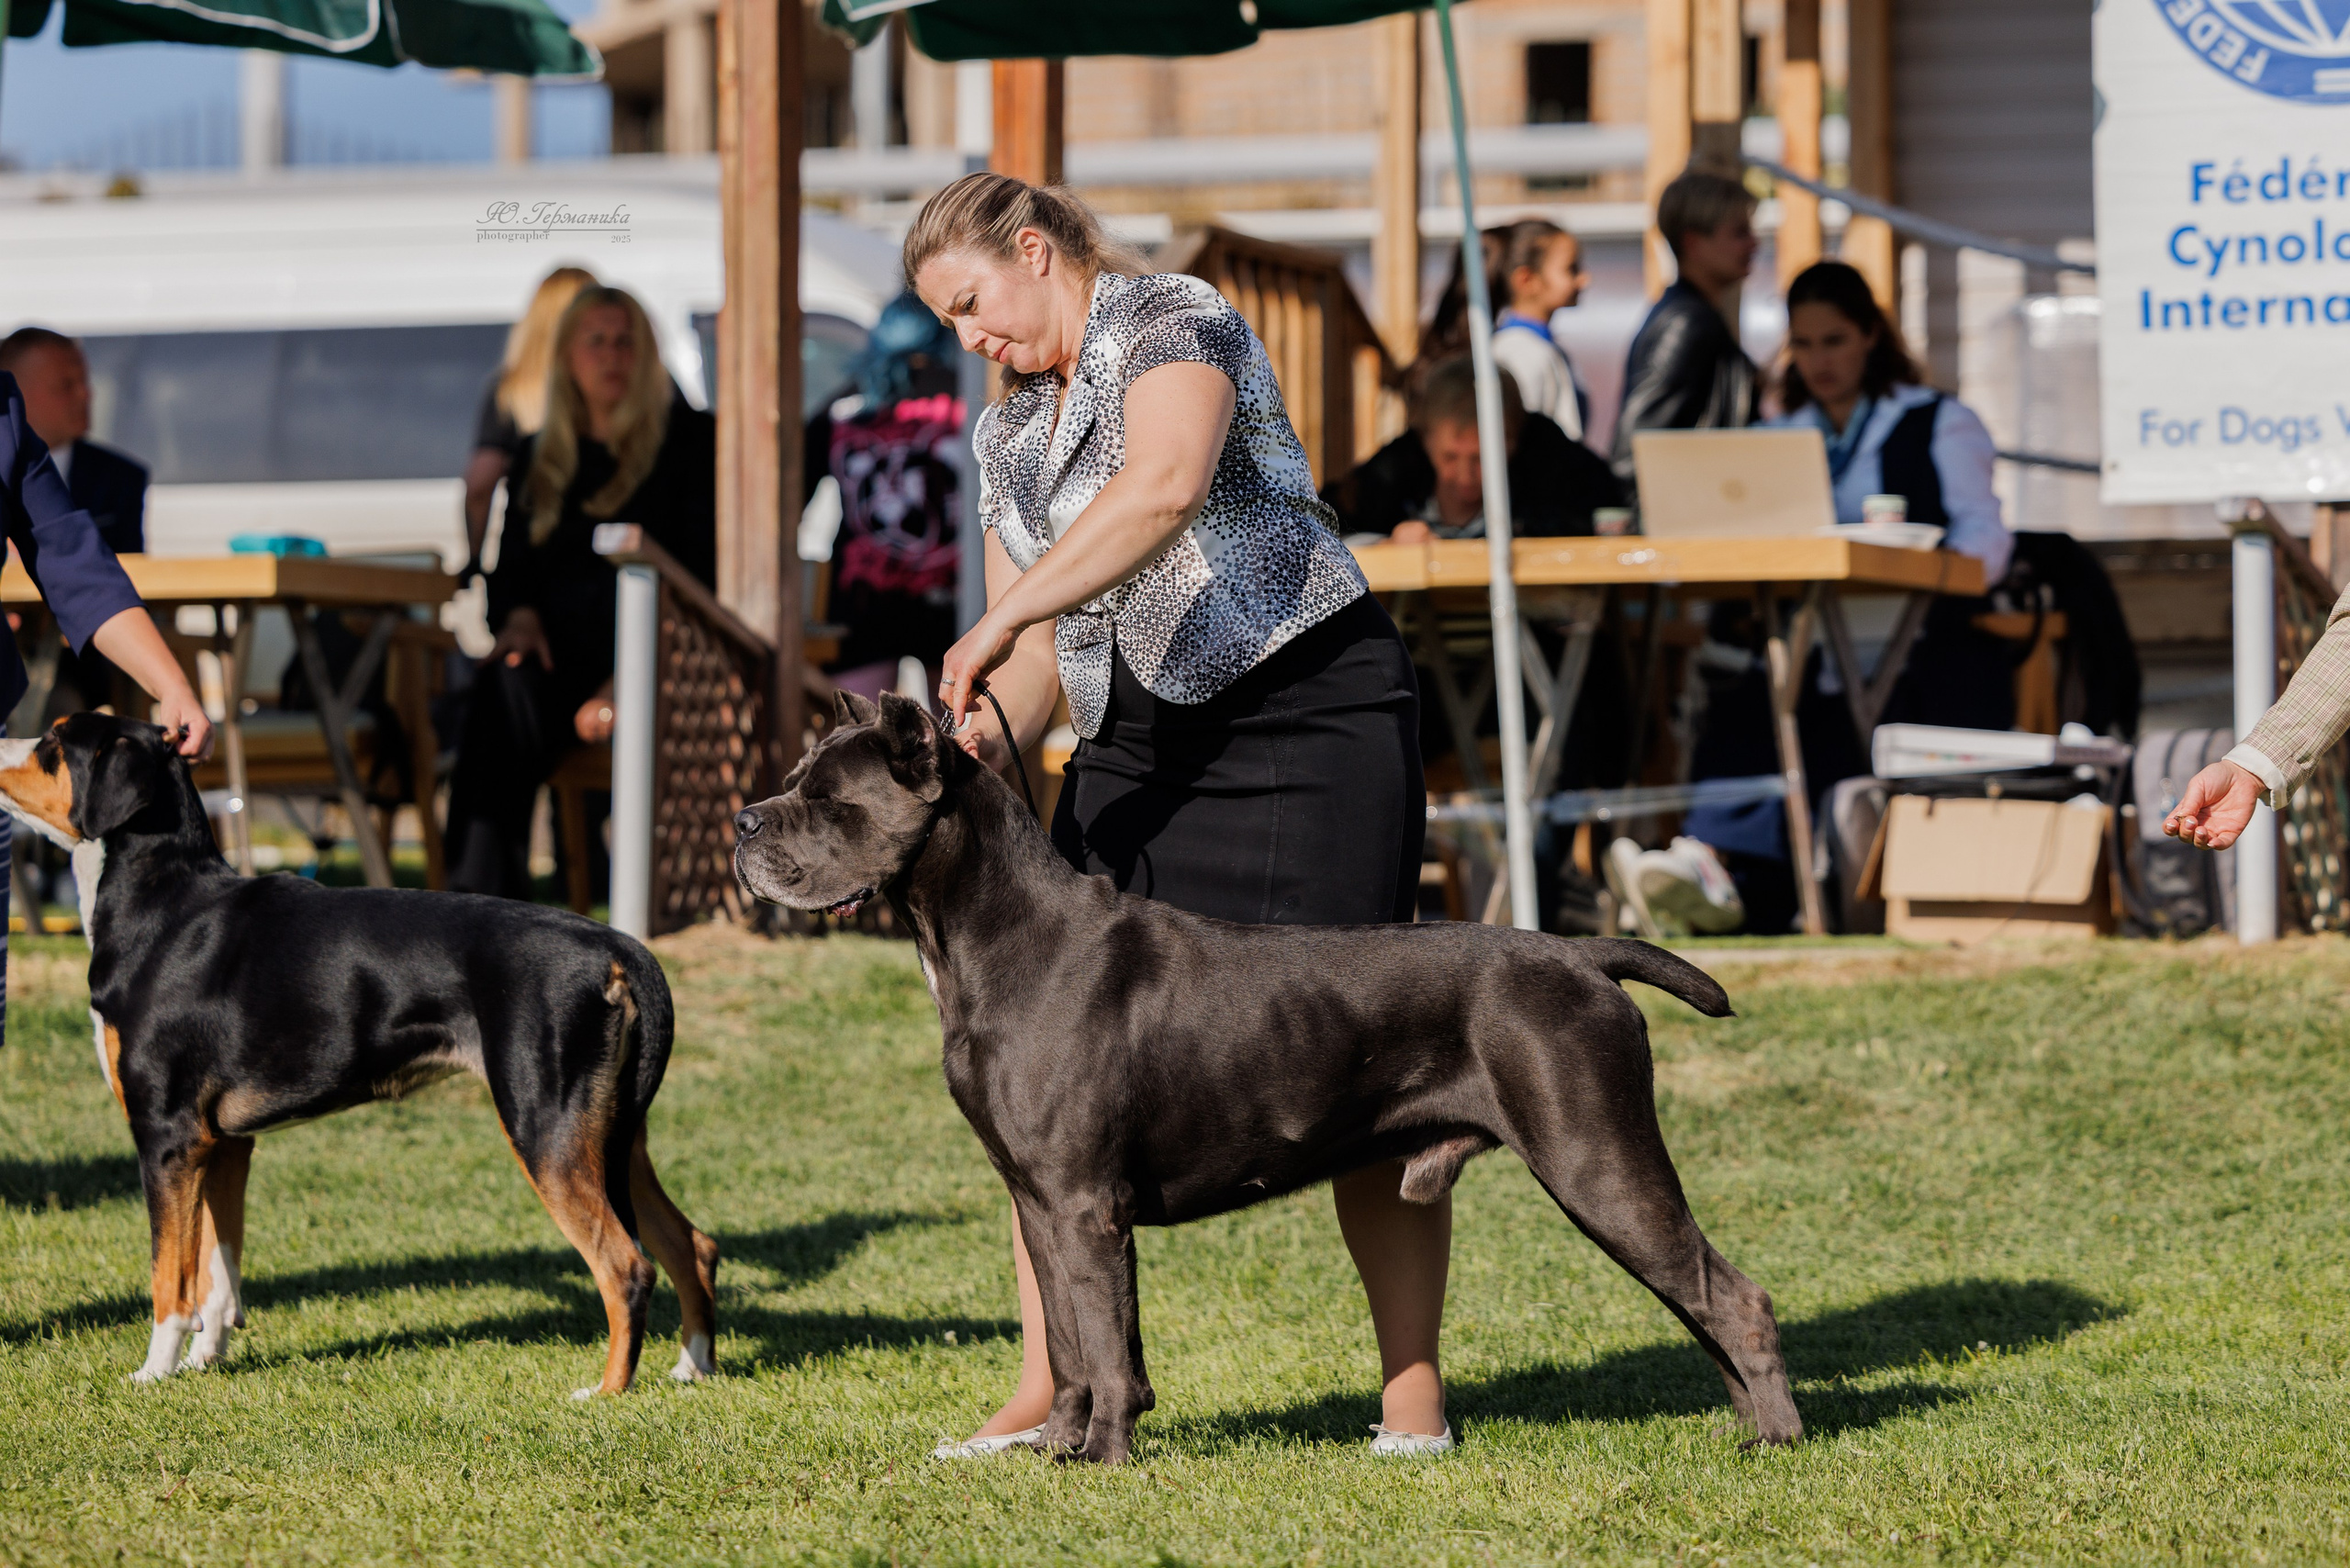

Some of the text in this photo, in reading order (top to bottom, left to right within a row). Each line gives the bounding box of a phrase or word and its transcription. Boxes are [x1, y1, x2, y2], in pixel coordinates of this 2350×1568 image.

[2141, 289, 2350, 330] Interna
[2140, 409, 2204, 447] For
[2219, 406, 2322, 454] Dogs
